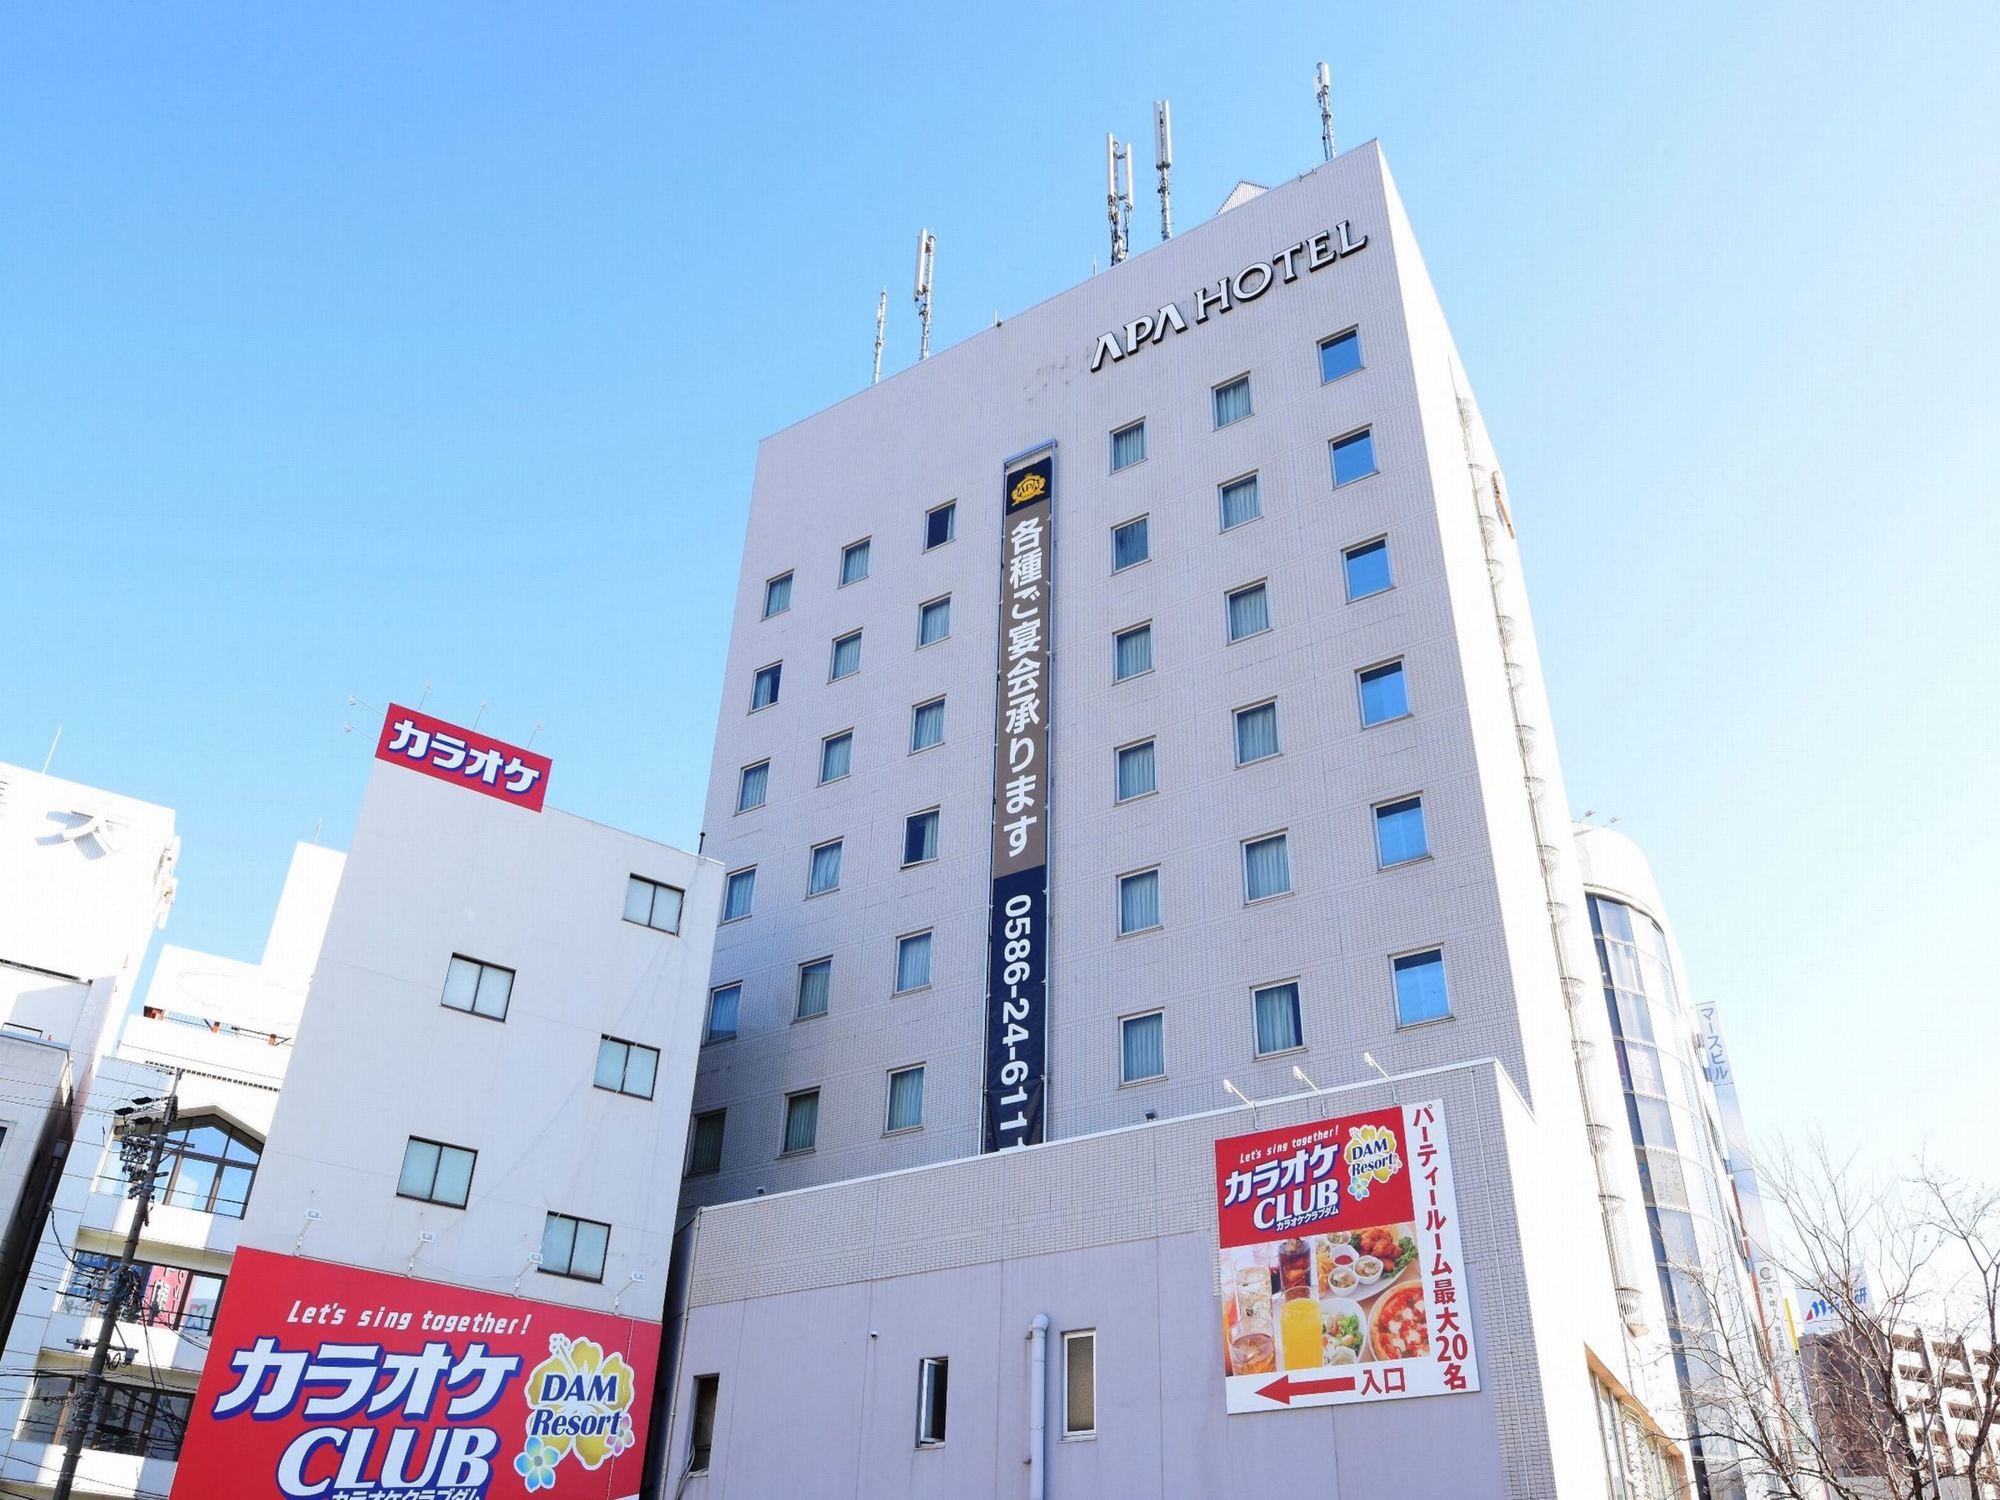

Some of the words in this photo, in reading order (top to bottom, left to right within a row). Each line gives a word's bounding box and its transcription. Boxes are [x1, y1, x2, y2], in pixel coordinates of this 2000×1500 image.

[1090, 301, 1188, 373] APA
[1195, 219, 1369, 324] HOTEL
[1003, 520, 1043, 858] 各種ご宴会承ります
[387, 718, 541, 794] カラオケ
[1701, 1007, 1728, 1080] マースビル
[1239, 1149, 1262, 1164] Let's
[1266, 1143, 1288, 1158] sing
[1291, 1125, 1340, 1150] together!
[1351, 1137, 1389, 1160] DAM
[1351, 1154, 1394, 1177] Resort
[1224, 1144, 1340, 1206] カラオケ
[1253, 1180, 1339, 1230] CLUB
[1276, 1208, 1339, 1232] カラオケクラブダム
[1412, 1105, 1468, 1390] パーティールーム最大20名
[287, 1299, 346, 1325] Let's
[357, 1306, 412, 1330] sing
[422, 1310, 532, 1335] together!
[213, 1336, 521, 1420] カラオケ
[542, 1374, 618, 1403] DAM
[1361, 1367, 1406, 1396] 入口
[532, 1408, 621, 1437] Resort
[277, 1427, 499, 1498] CLUB
